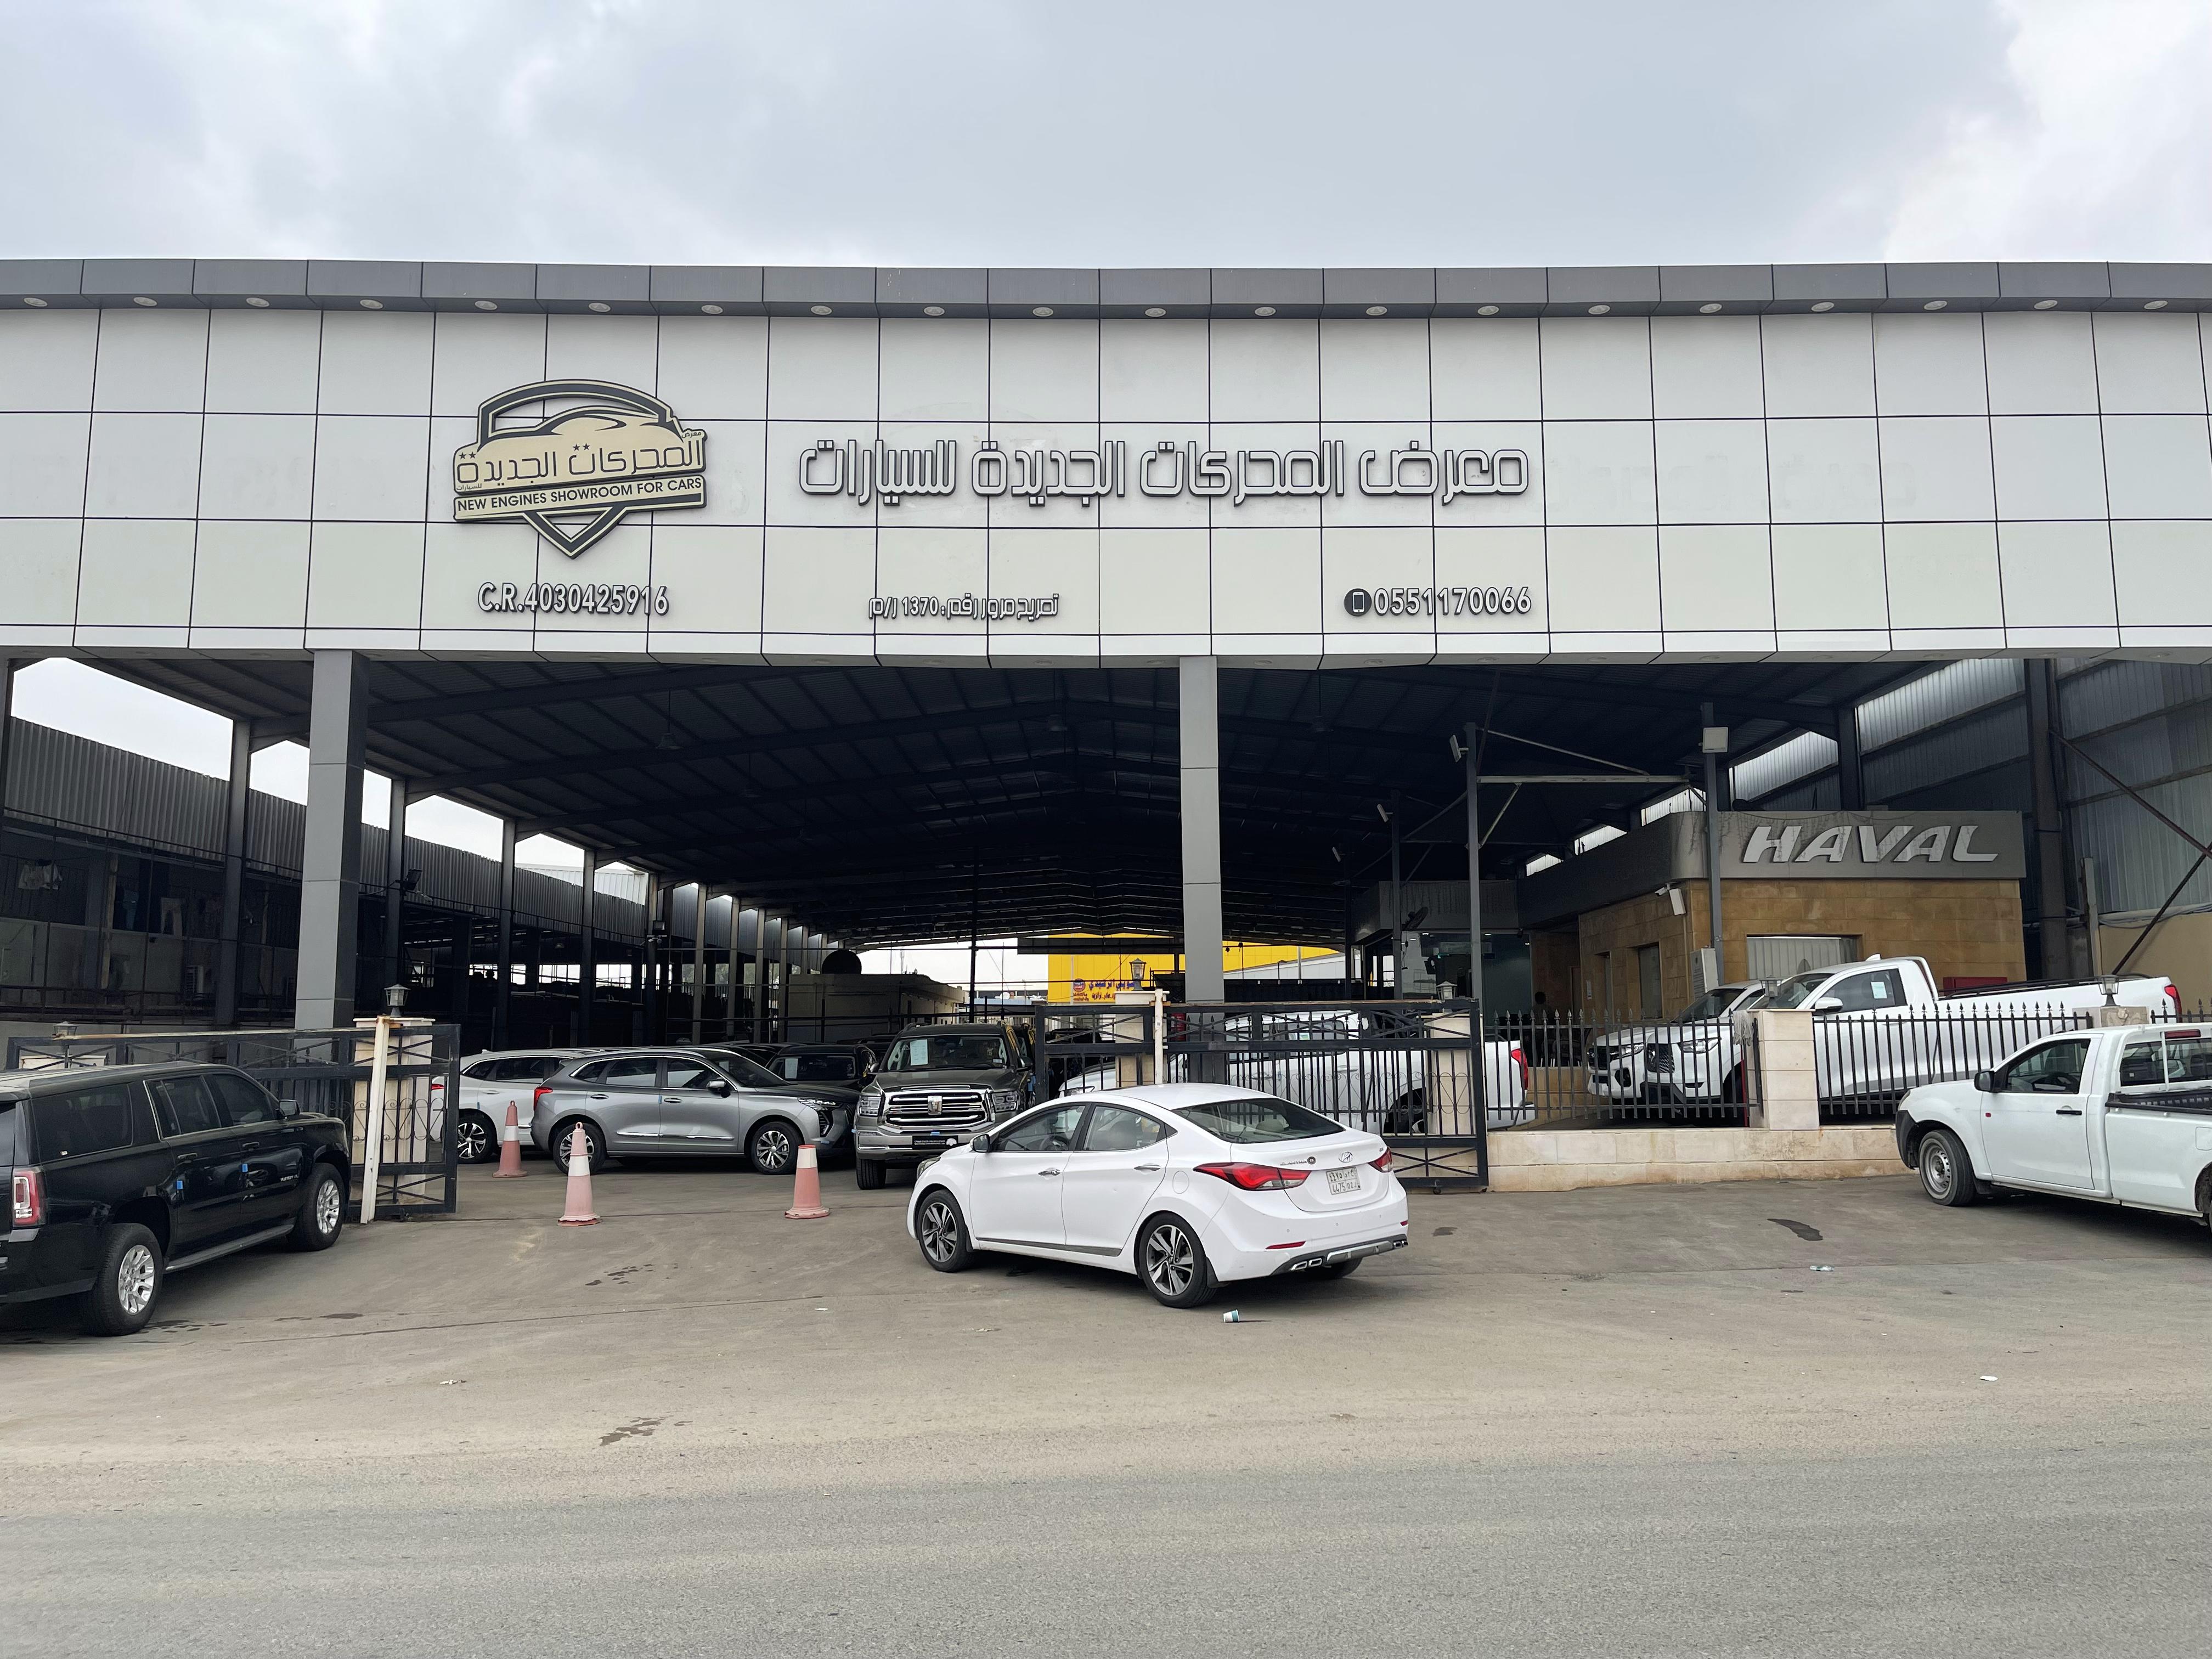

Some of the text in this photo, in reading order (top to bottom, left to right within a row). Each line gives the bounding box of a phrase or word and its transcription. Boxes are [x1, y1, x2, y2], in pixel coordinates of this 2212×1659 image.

[457, 440, 701, 486] المحركات الجديدة
[799, 439, 1529, 507] معرض المحركات الجديدة للسيارات
[456, 483, 482, 491] للسيارات
[458, 477, 702, 511] NEW ENGINES SHOWROOM FOR CARS
[477, 582, 669, 616] C.R.4030425916
[901, 596, 939, 617] 1370
[1017, 592, 1059, 622] تصريح
[1374, 586, 1532, 616] 0551170066
[1742, 825, 1999, 864] HAVAL
